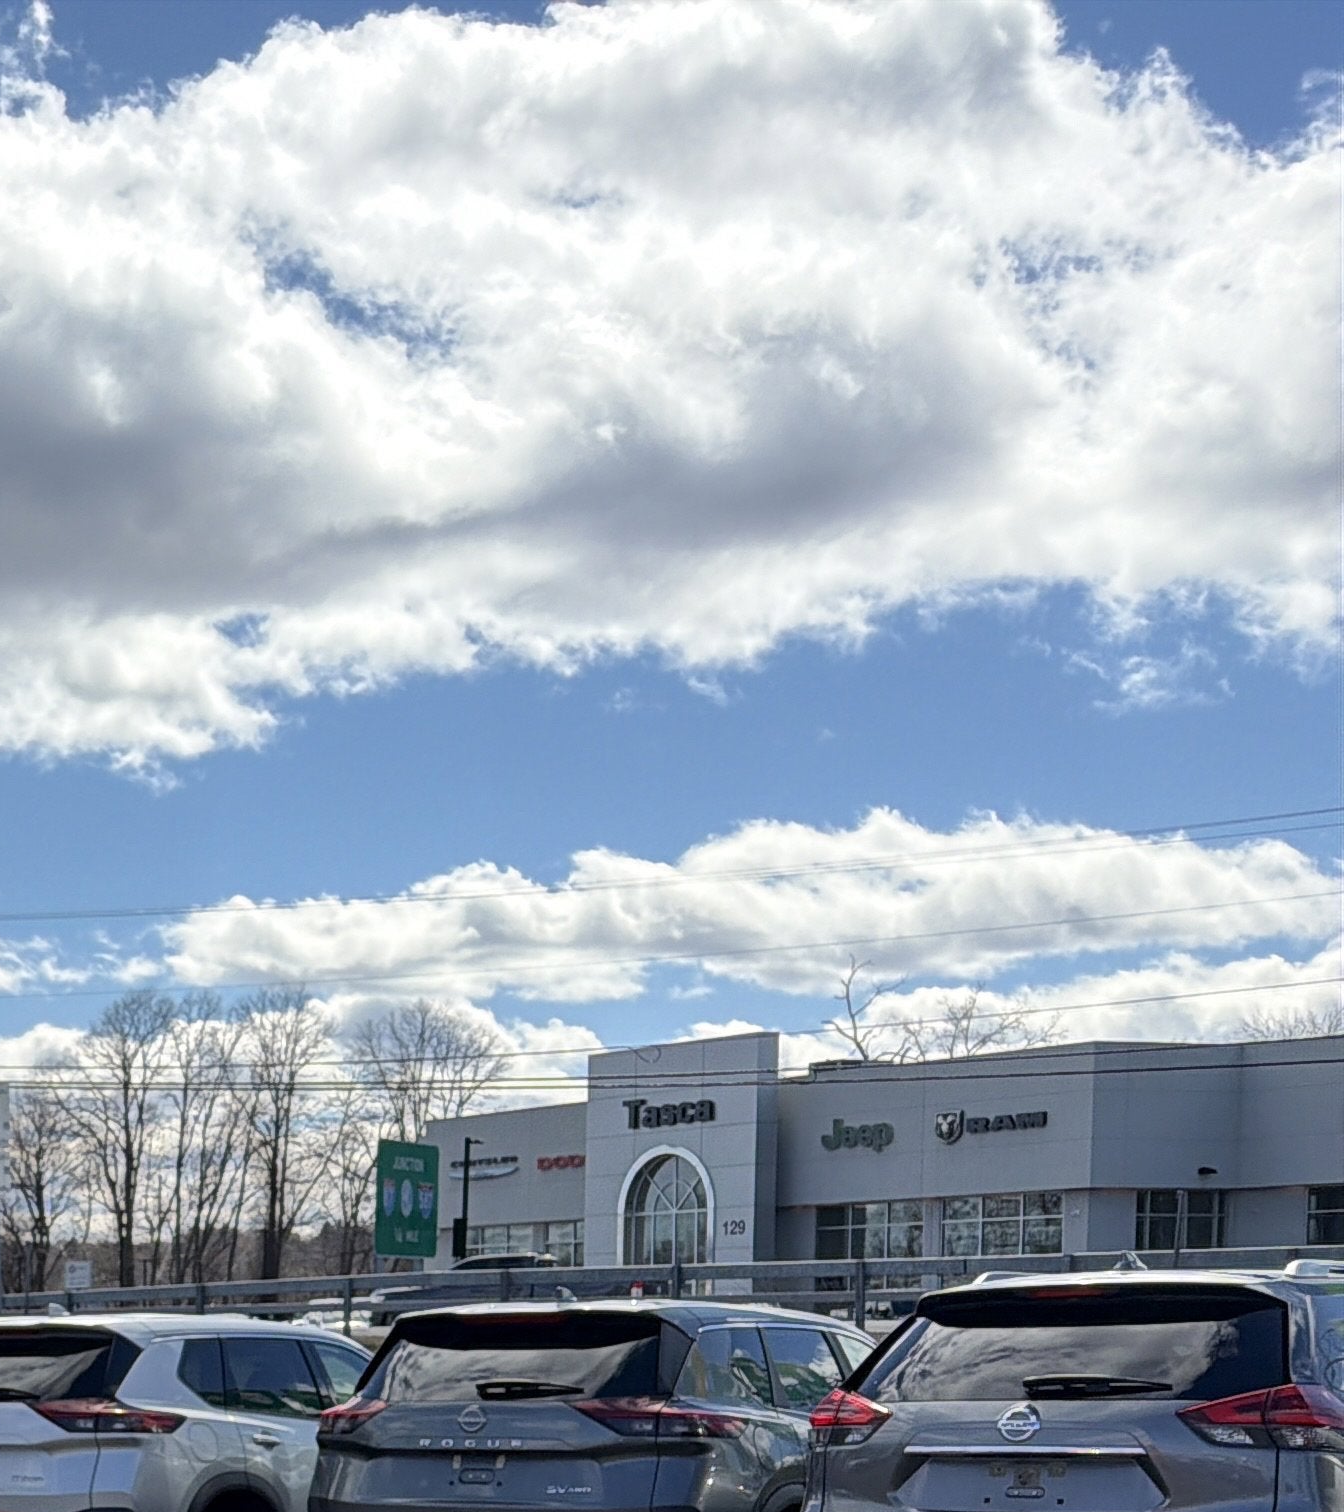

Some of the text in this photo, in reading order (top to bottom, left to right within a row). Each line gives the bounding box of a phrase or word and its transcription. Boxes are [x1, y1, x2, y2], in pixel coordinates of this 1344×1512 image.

[622, 1099, 716, 1130] Tasca
[965, 1111, 1049, 1135] RAM
[820, 1118, 894, 1153] Jeep
[537, 1155, 585, 1170] DOD
[723, 1220, 746, 1236] 129
[419, 1438, 523, 1448] ROGUE
